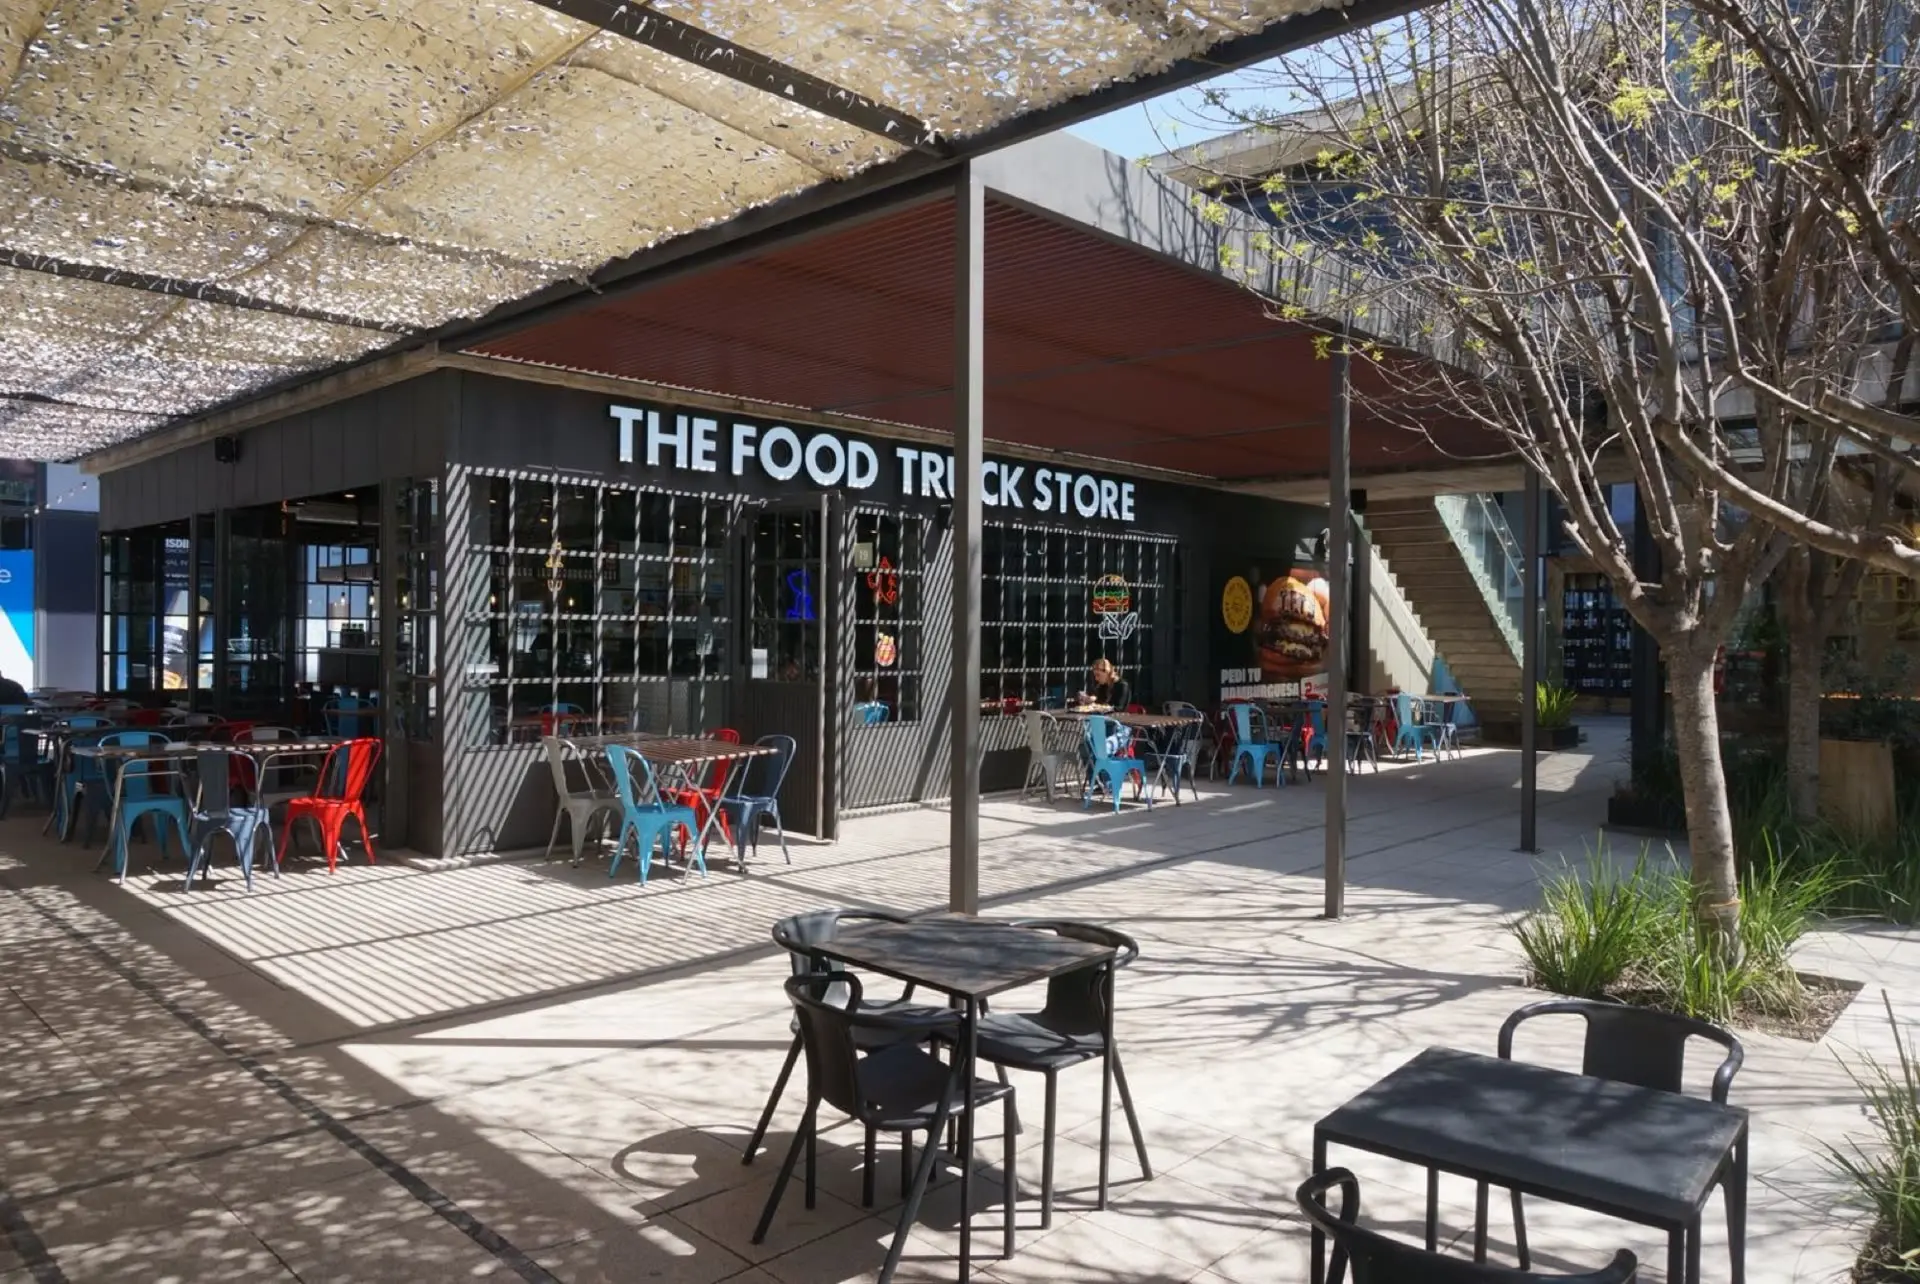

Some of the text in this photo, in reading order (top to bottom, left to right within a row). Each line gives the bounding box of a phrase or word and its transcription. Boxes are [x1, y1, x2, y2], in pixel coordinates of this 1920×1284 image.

[610, 404, 717, 472] THE
[731, 423, 878, 489] FOOD
[1033, 468, 1135, 521] STORE
[1247, 667, 1261, 682] TU
